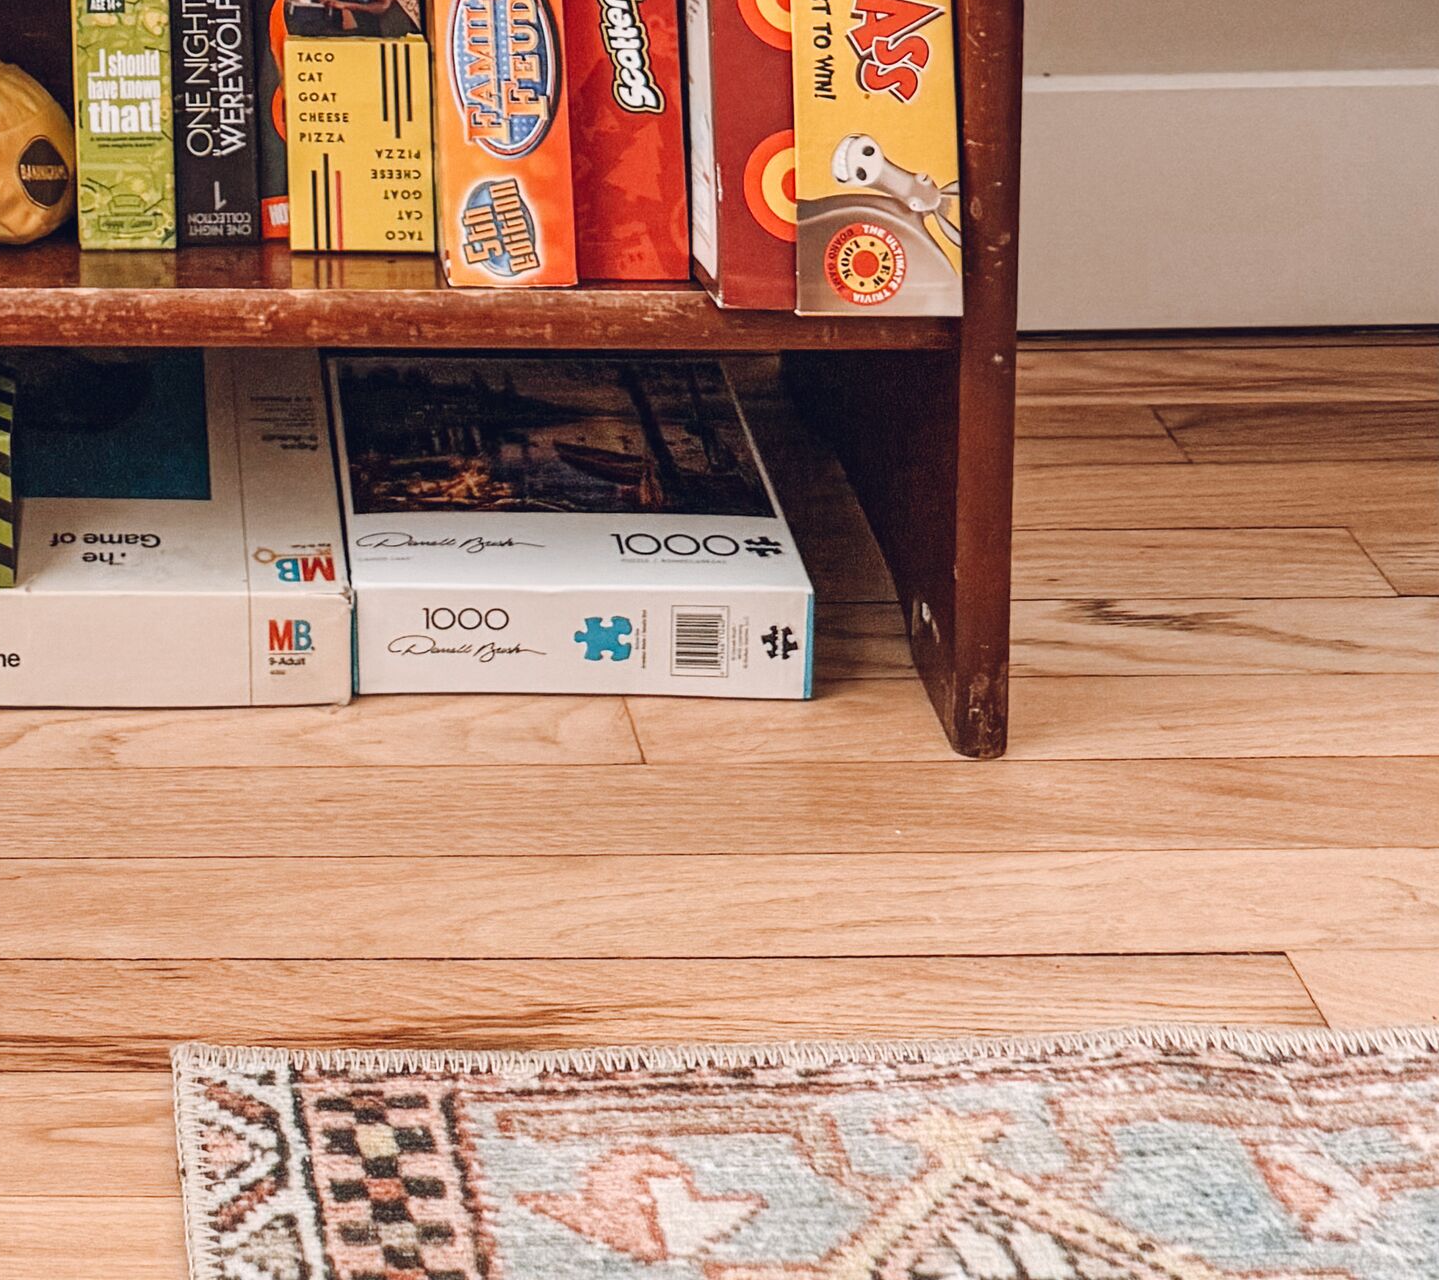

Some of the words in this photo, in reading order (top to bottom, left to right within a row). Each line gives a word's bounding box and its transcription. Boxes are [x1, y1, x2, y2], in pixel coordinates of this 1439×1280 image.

[297, 52, 335, 62] TACO
[298, 72, 323, 82] CAT
[299, 92, 337, 102] GOAT
[88, 101, 160, 133] that!
[299, 113, 349, 123] CHEESE
[185, 91, 213, 157] ONE
[299, 132, 345, 143] PIZZA
[375, 149, 421, 159] PIZZA
[371, 169, 421, 179] CHEESE
[383, 190, 422, 200] GOAT
[188, 213, 251, 222] COLLECTION
[398, 210, 423, 220] CAT
[385, 230, 423, 240] TACO
[610, 533, 740, 557] 1000
[275, 557, 336, 582] MB
[422, 606, 509, 631] 1000
